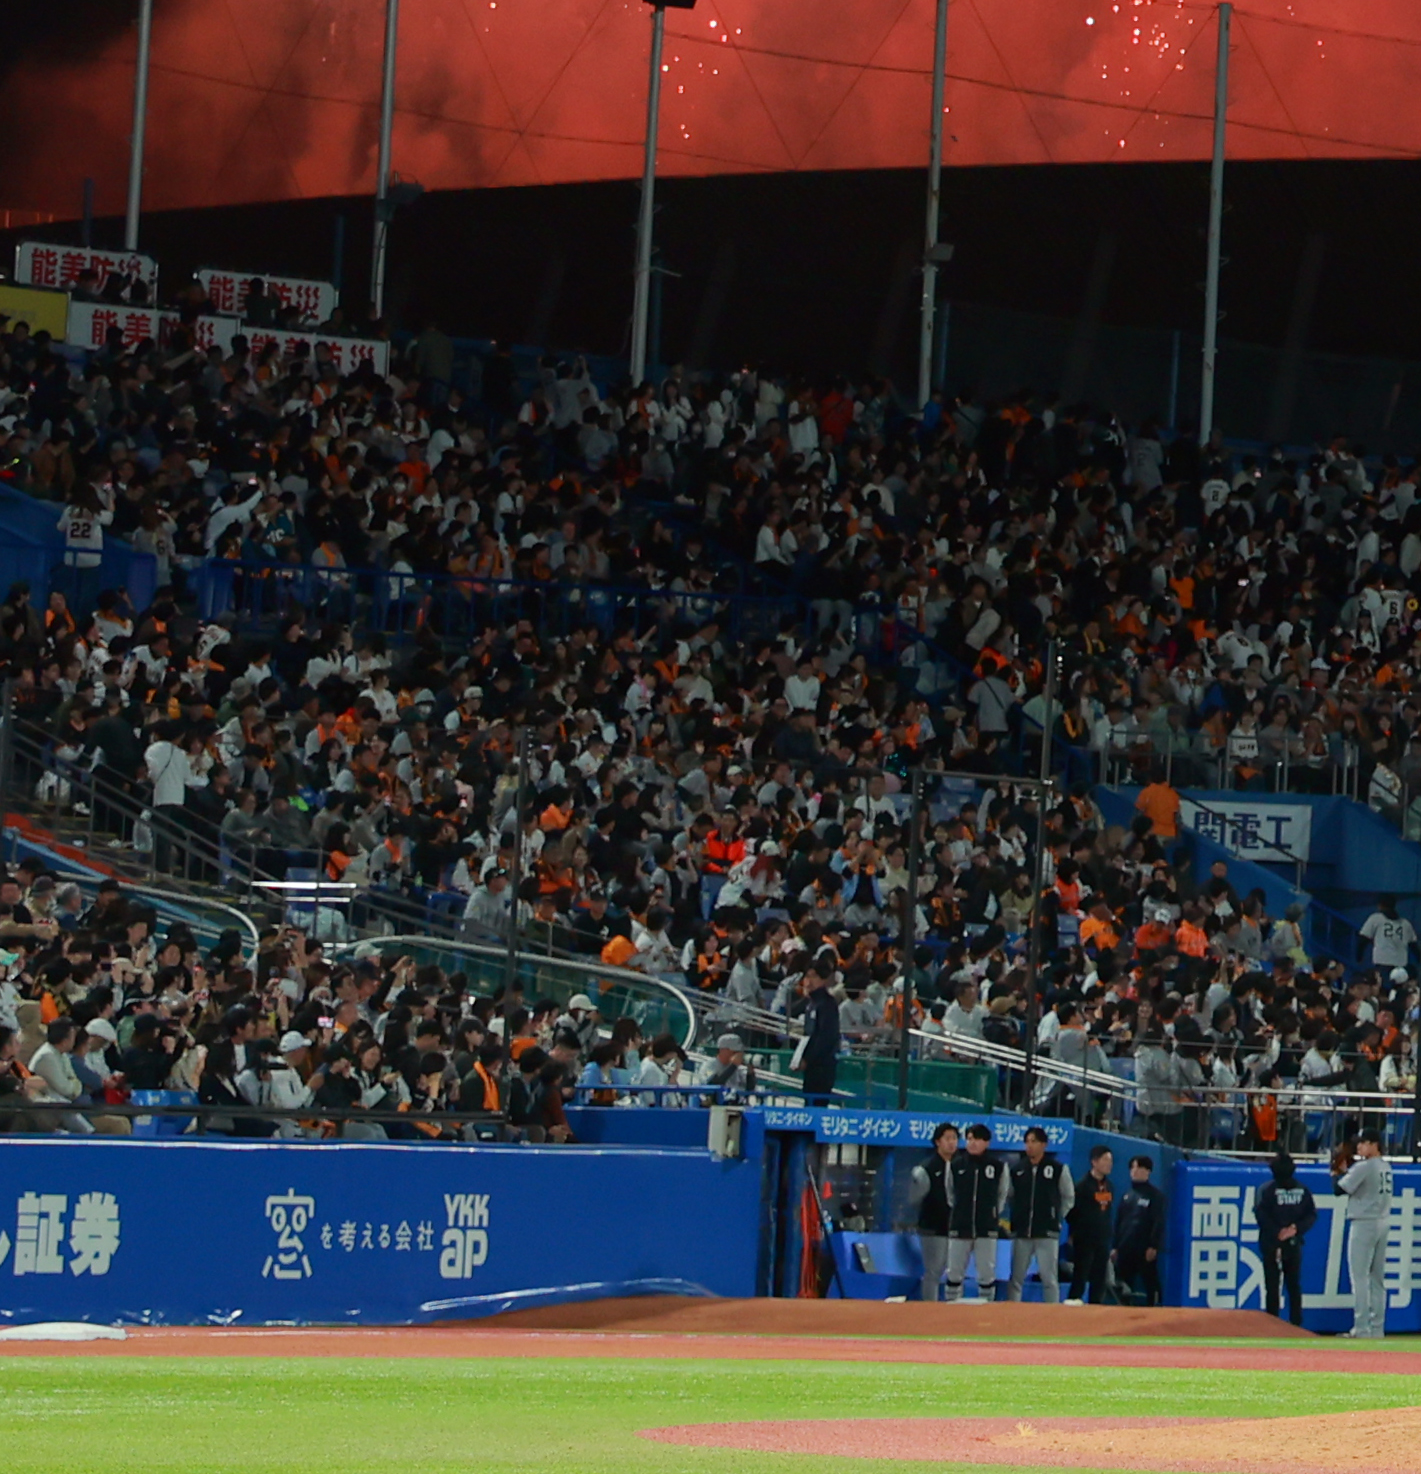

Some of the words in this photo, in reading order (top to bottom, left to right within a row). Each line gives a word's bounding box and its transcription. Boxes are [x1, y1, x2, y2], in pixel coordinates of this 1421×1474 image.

[70, 522, 91, 539] 22
[1195, 811, 1292, 849] 関電工
[1381, 922, 1403, 940] 24
[444, 1194, 490, 1227] YKK
[0, 1191, 120, 1277] 証券
